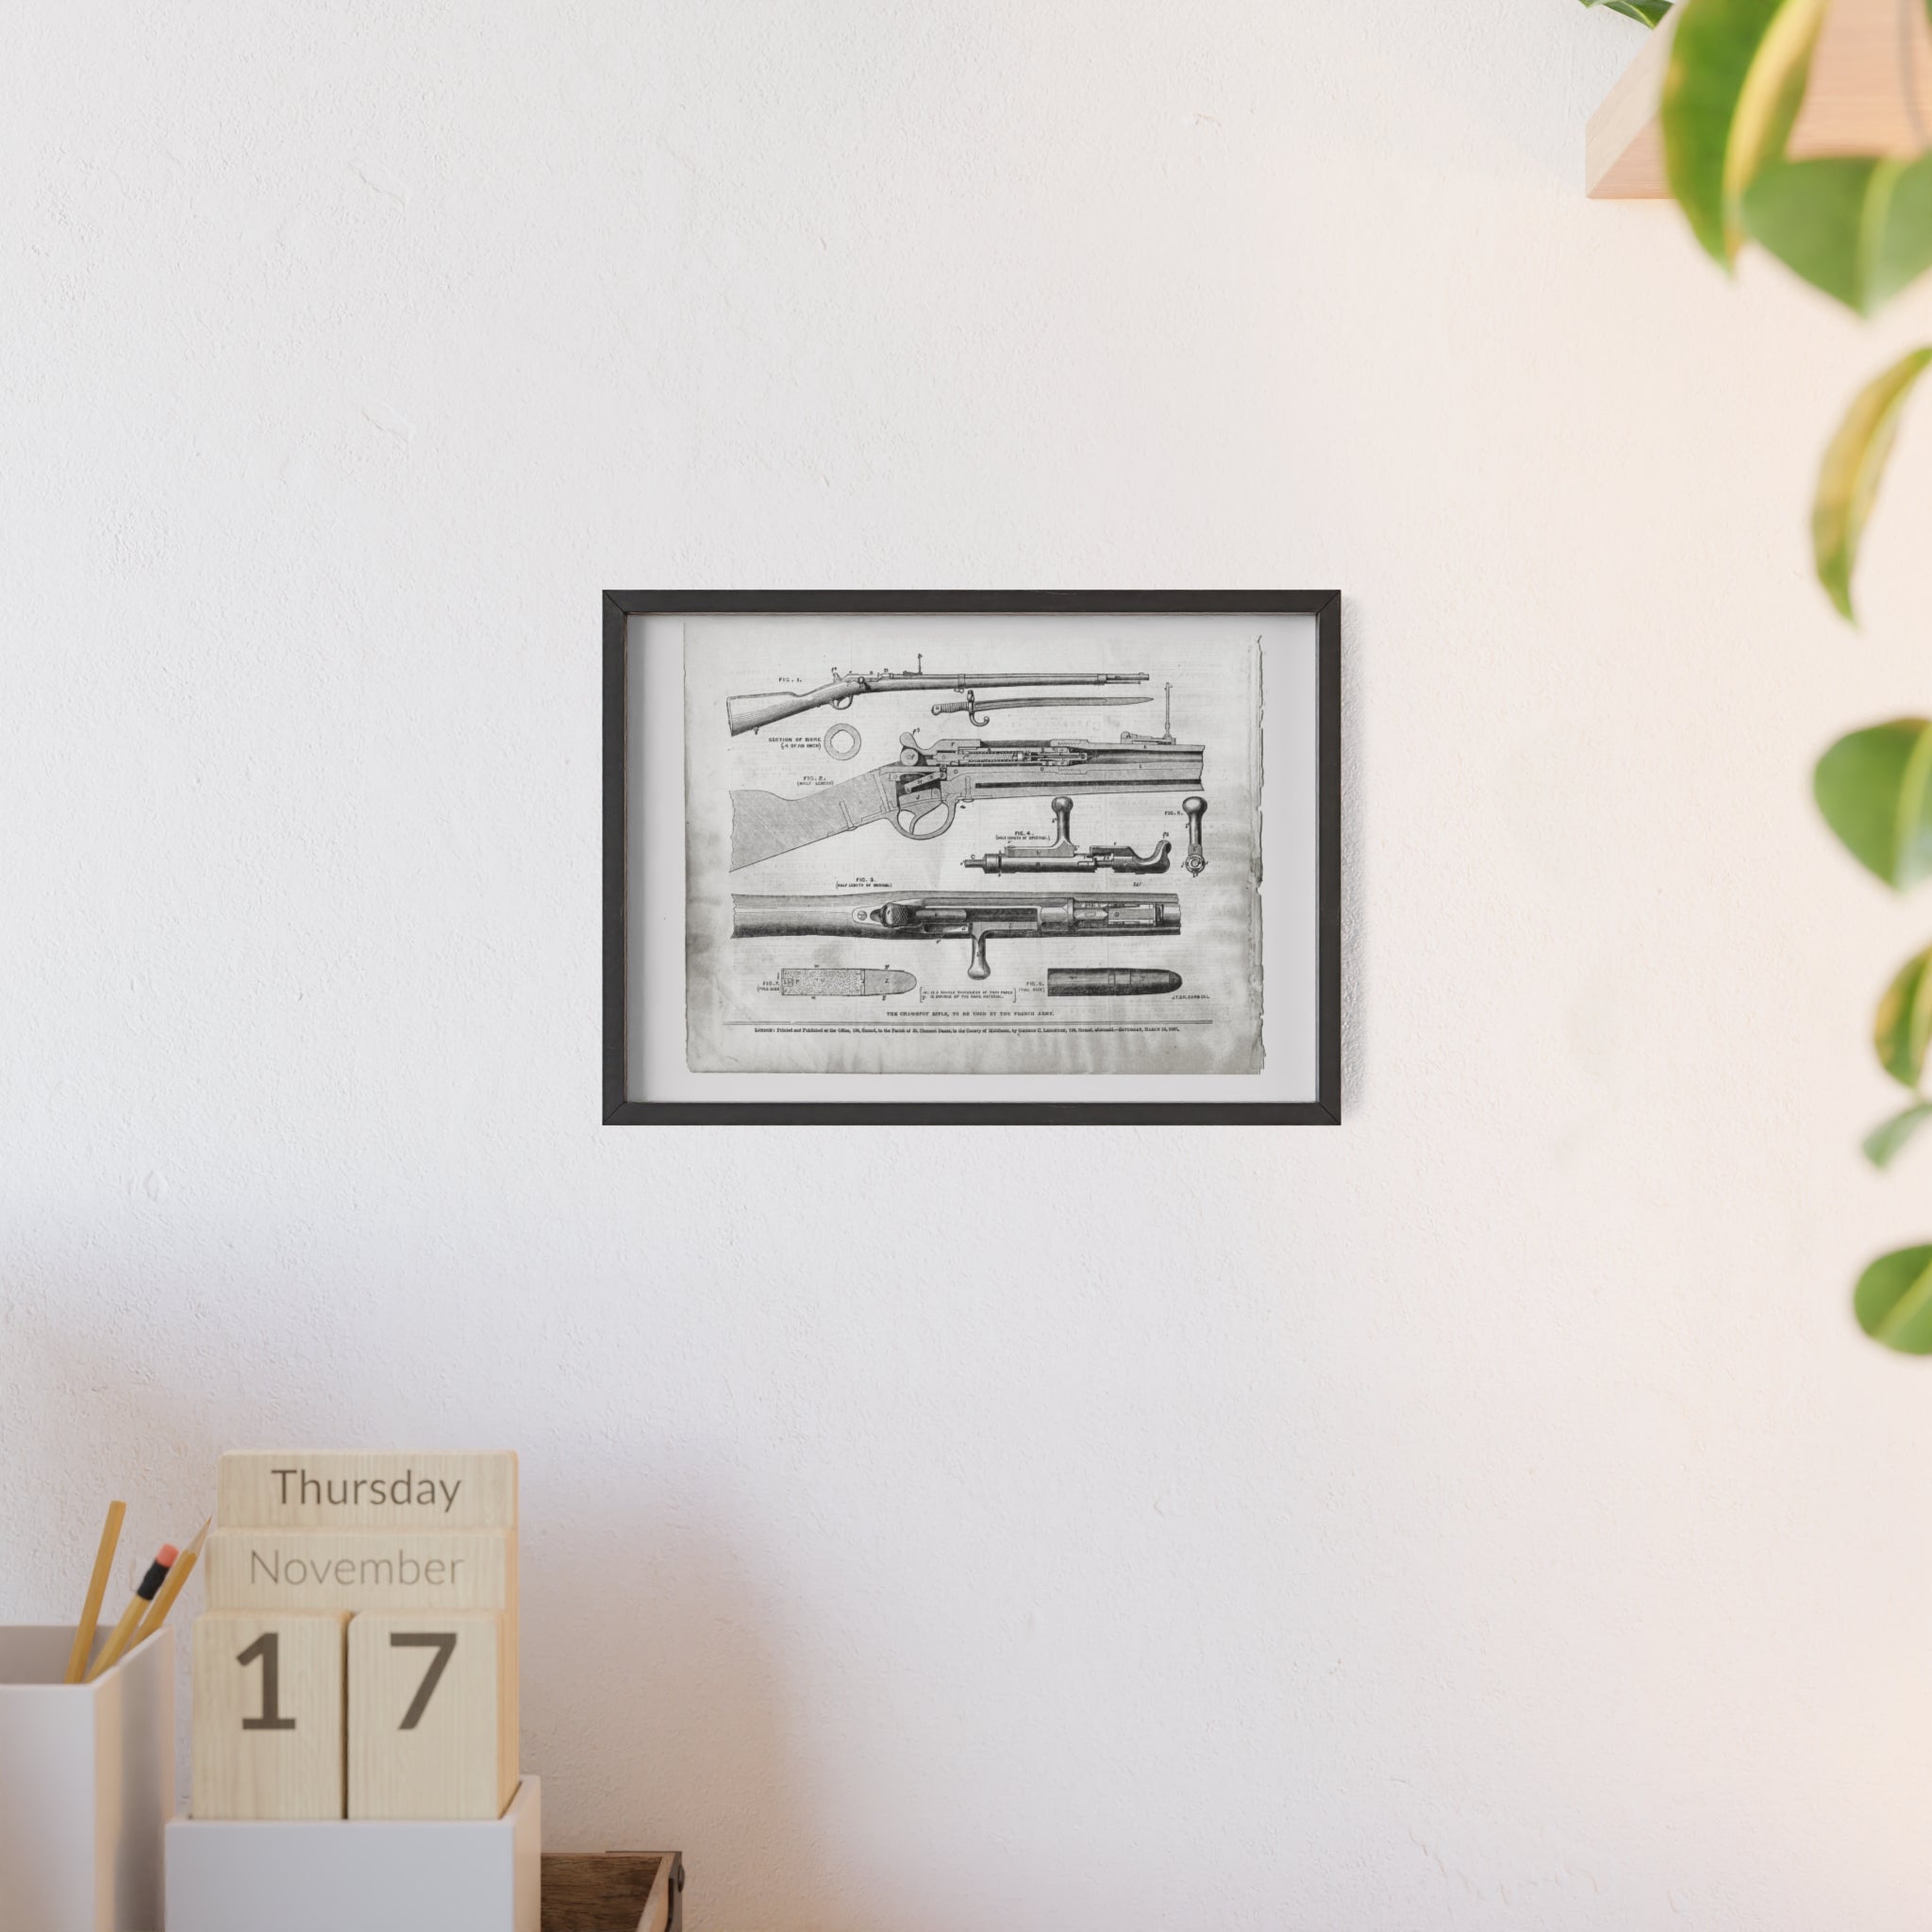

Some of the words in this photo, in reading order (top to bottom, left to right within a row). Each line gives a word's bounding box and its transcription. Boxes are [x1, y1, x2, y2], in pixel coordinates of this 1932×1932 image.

[271, 1469, 462, 1512] Thursday
[250, 1549, 465, 1586] November
[236, 1632, 297, 1731] 1
[390, 1632, 458, 1731] 7
